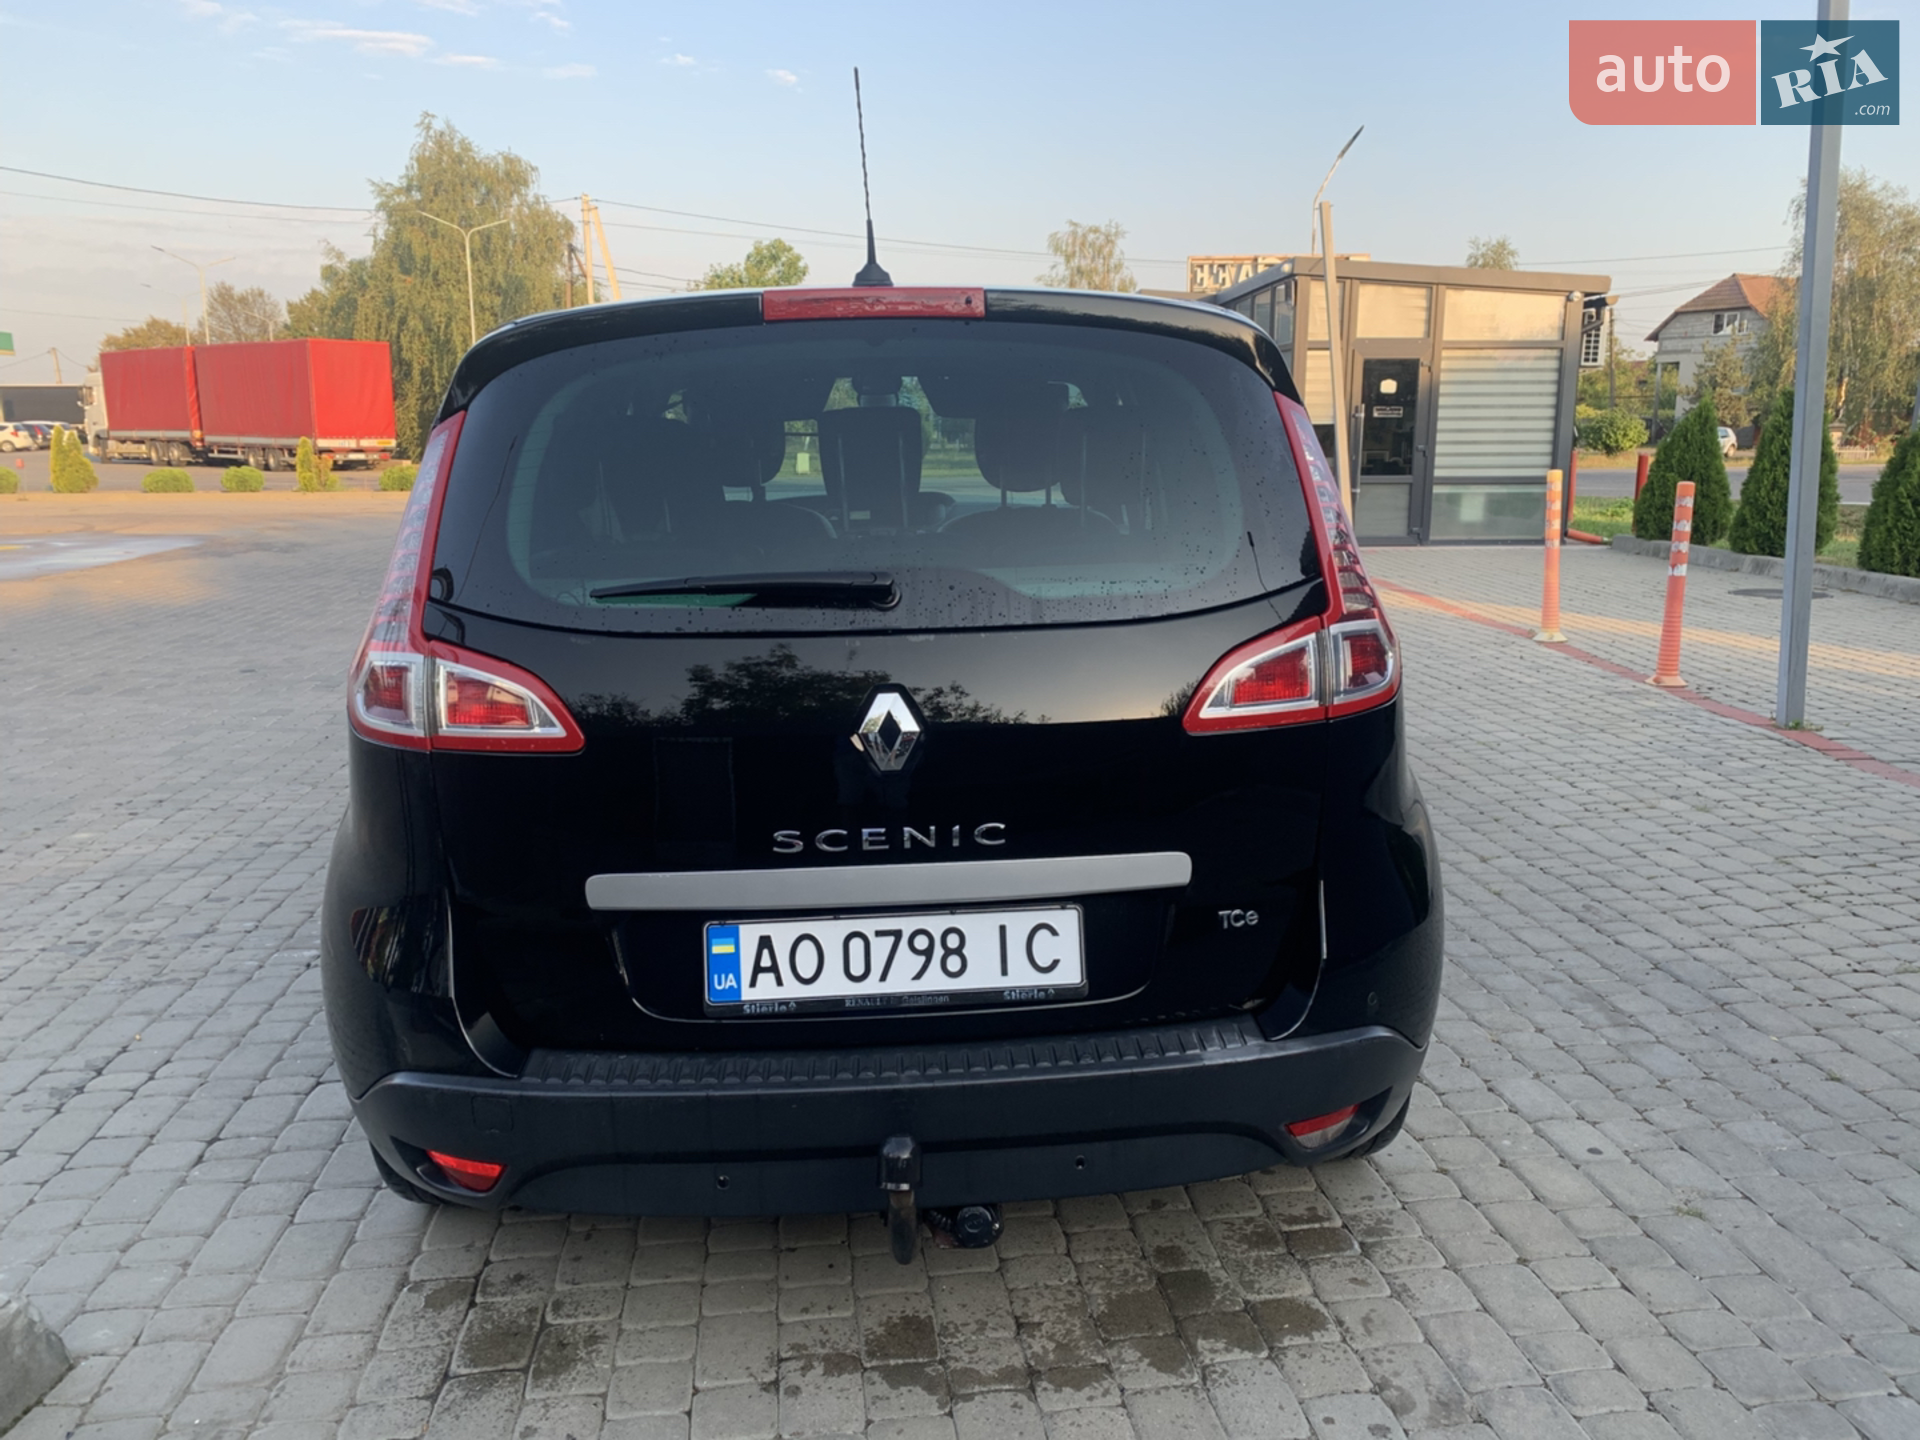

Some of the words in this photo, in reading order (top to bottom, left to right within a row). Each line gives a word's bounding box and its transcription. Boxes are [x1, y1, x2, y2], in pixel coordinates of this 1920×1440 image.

[772, 822, 1006, 854] SCENIC
[1217, 908, 1259, 929] TCe
[748, 932, 825, 989] AO
[842, 926, 968, 984] 0798
[998, 922, 1061, 977] IC
[713, 974, 738, 991] UA
